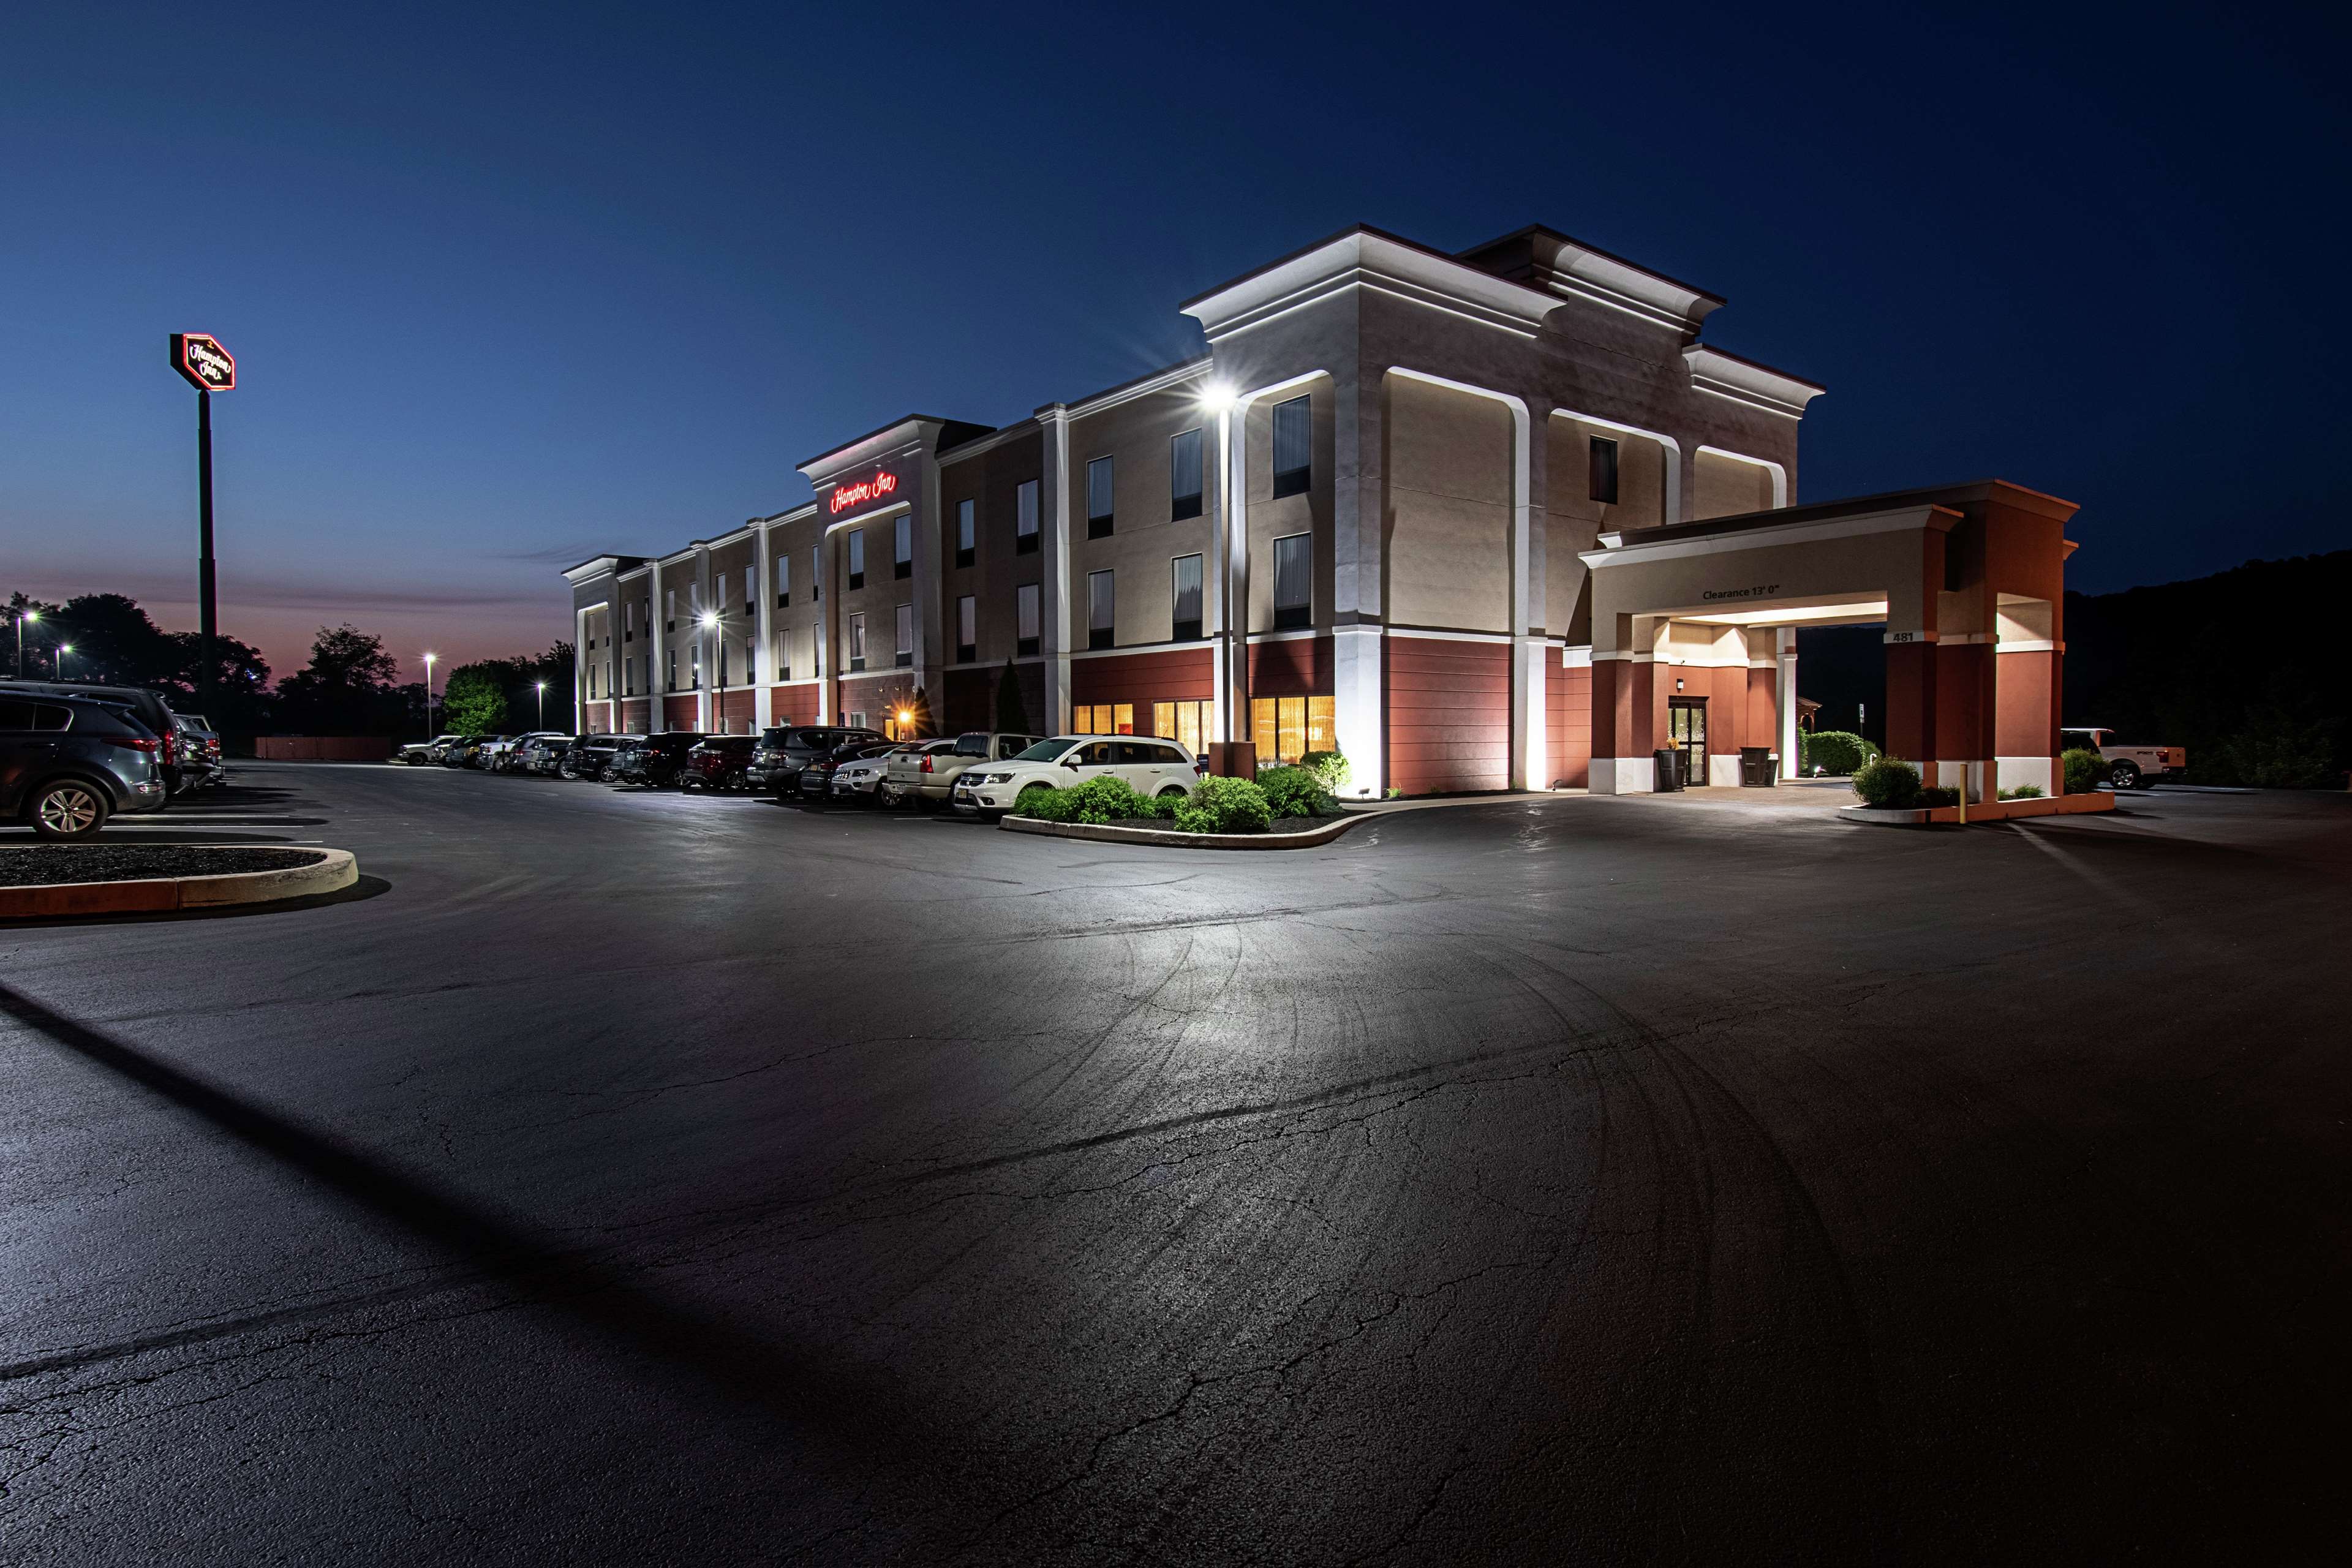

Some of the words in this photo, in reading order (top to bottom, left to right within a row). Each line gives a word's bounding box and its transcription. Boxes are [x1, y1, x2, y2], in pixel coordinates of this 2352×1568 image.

[189, 344, 232, 374] Hampton
[831, 483, 871, 513] Hampton
[872, 472, 896, 497] Inn
[1703, 589, 1750, 600] Clearance
[1751, 586, 1766, 596] 13'
[1893, 632, 1913, 643] 481
